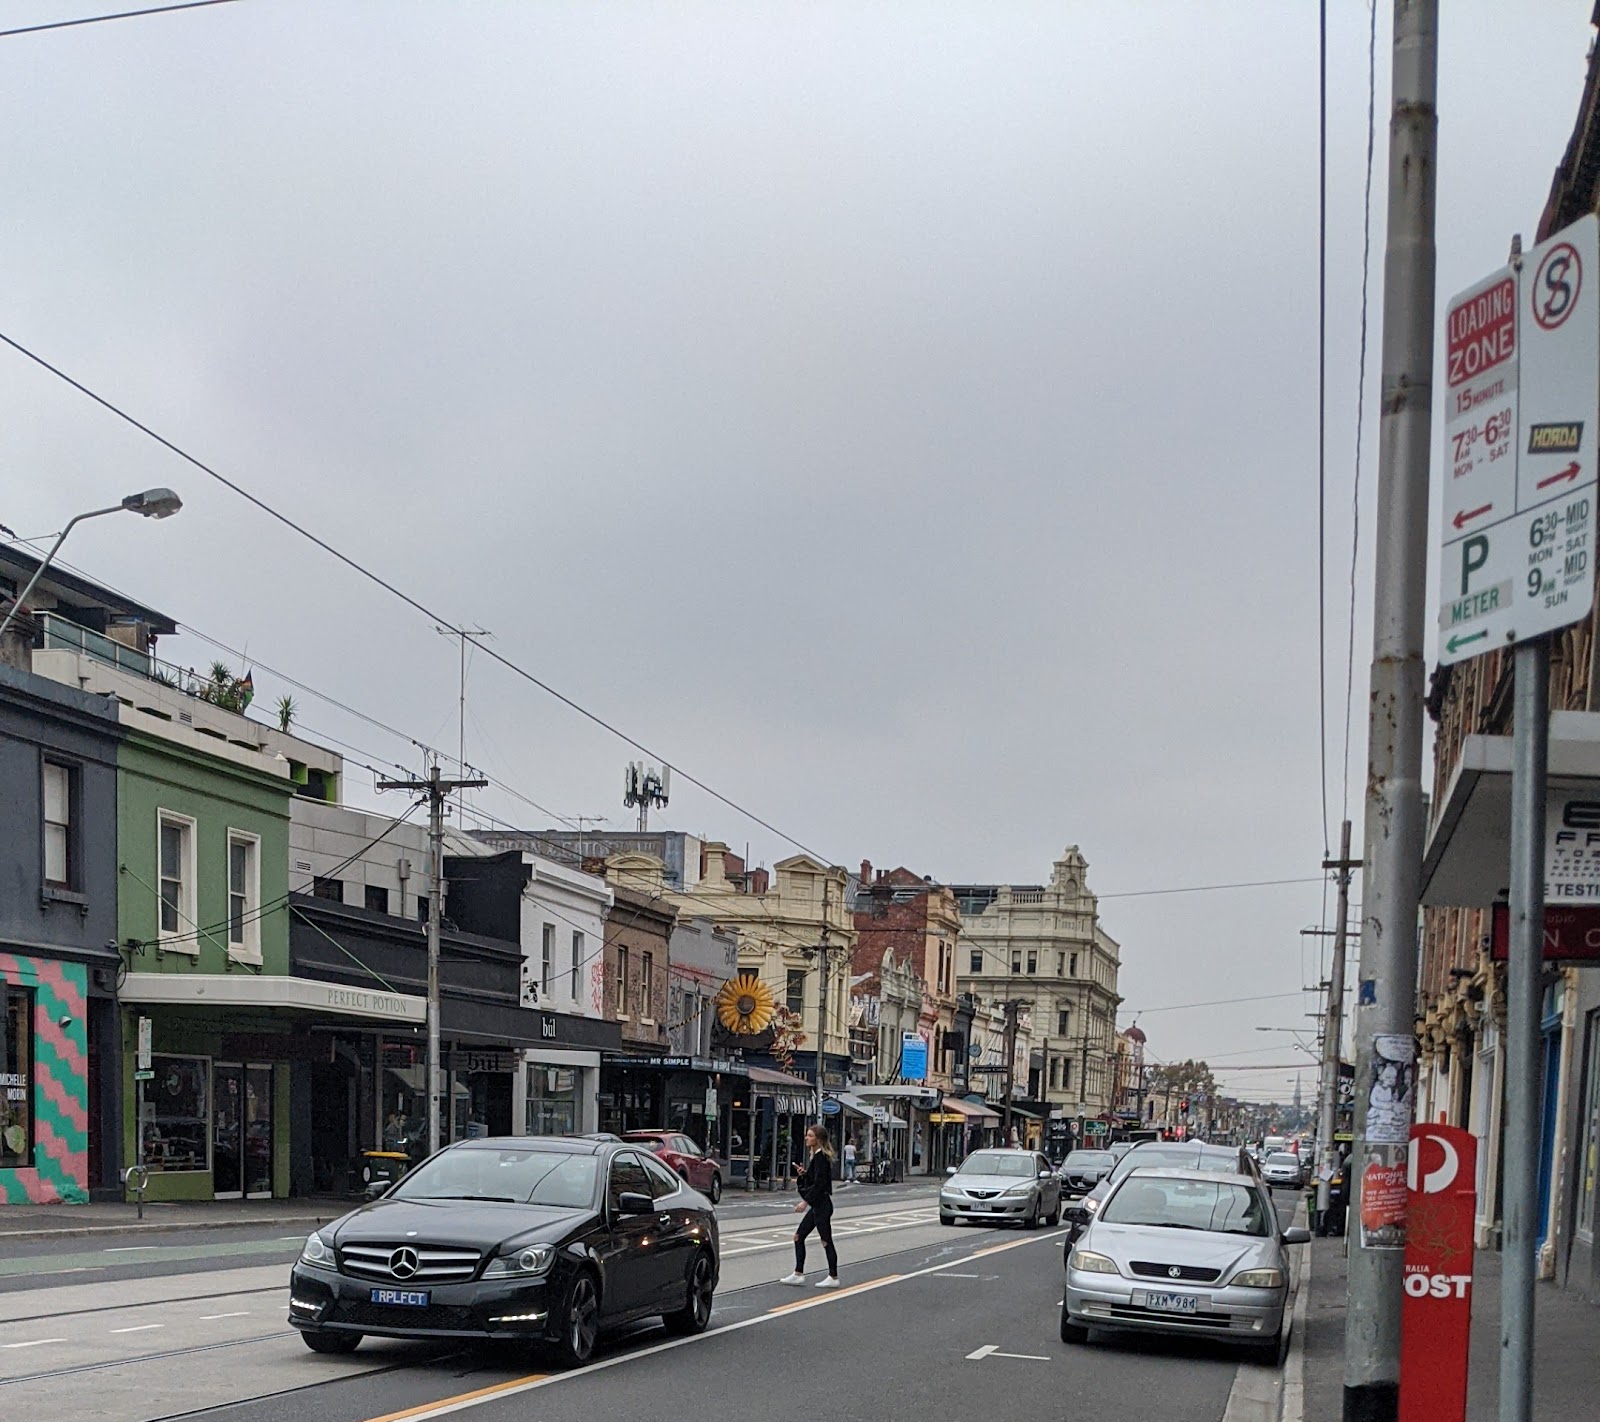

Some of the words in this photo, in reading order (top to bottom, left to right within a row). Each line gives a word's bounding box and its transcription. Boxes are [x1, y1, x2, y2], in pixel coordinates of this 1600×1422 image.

[1450, 282, 1512, 344] LOADING
[1449, 321, 1513, 384] ZONE
[1457, 388, 1472, 414] 15
[1473, 378, 1504, 406] MINUTE
[1453, 461, 1474, 480] MON
[1489, 441, 1510, 463] SAT
[1528, 547, 1554, 566] MON
[1565, 532, 1589, 553] SAT
[1461, 533, 1490, 596] P
[1527, 567, 1543, 598] 9
[1563, 550, 1588, 577] MID
[1451, 585, 1500, 625] METER
[1544, 590, 1569, 610] SUN
[1555, 883, 1600, 897] TESTI
[328, 989, 369, 1008] PERFECT
[373, 996, 407, 1014] POTION
[542, 1016, 557, 1038] búl
[650, 1057, 661, 1065] MR
[663, 1058, 690, 1066] SIMPLE
[1405, 1264, 1430, 1273] RALIA
[378, 1290, 425, 1305] RPLFCT
[1403, 1272, 1472, 1299] OST
